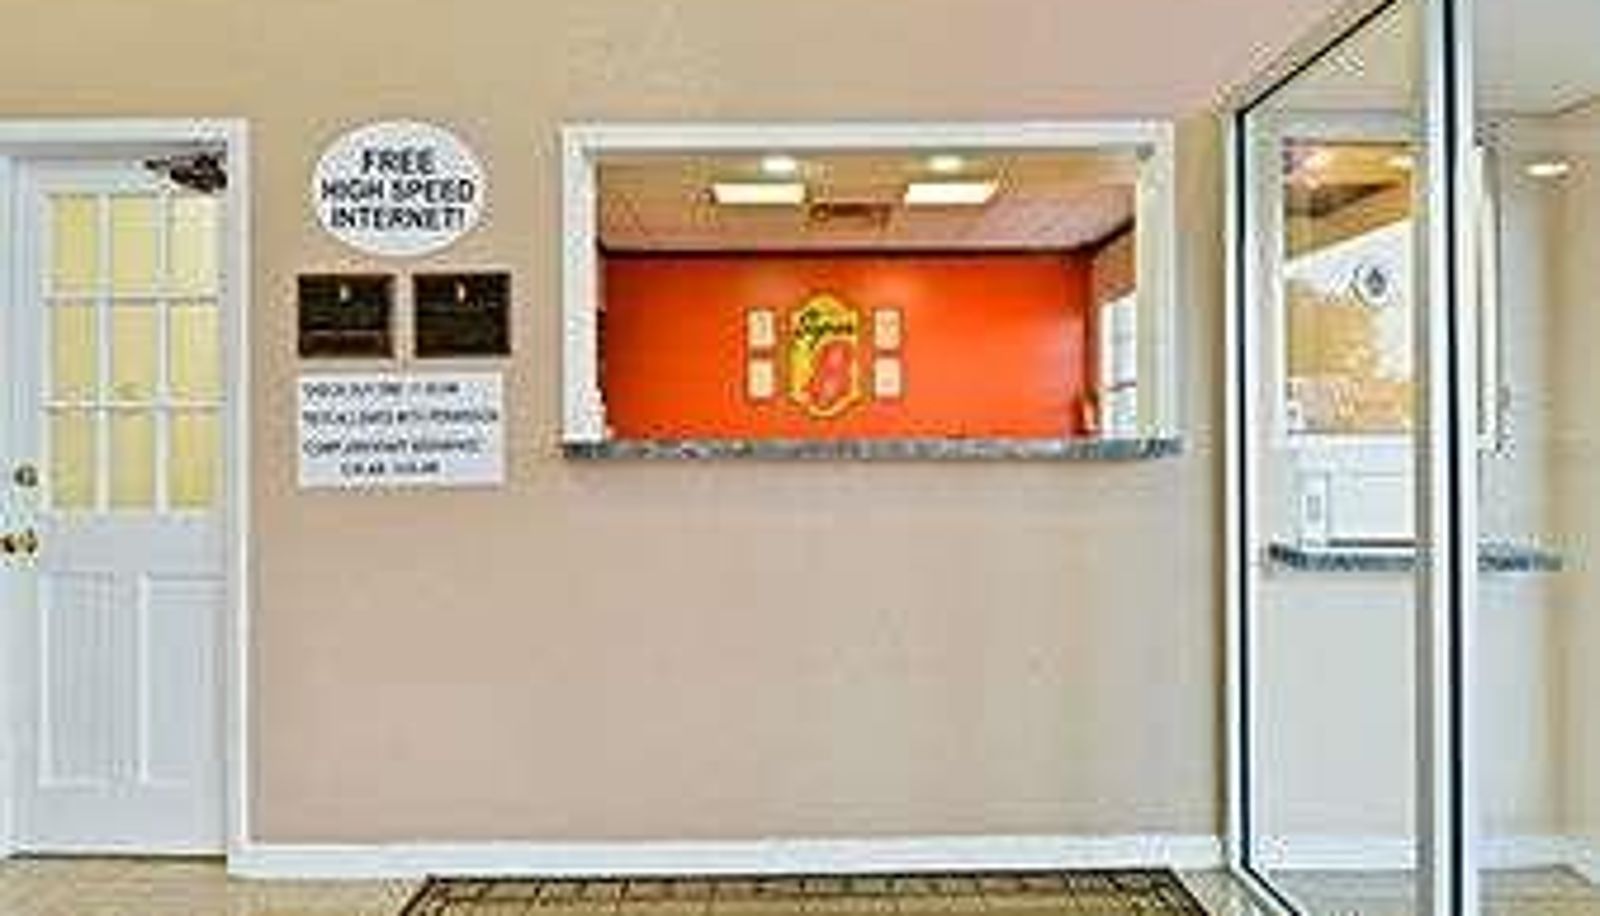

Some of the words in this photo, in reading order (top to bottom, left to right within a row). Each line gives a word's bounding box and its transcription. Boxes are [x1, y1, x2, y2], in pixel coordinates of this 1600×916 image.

[361, 149, 435, 174] FREE
[321, 179, 384, 202] HIGH
[391, 179, 475, 203] SPEED
